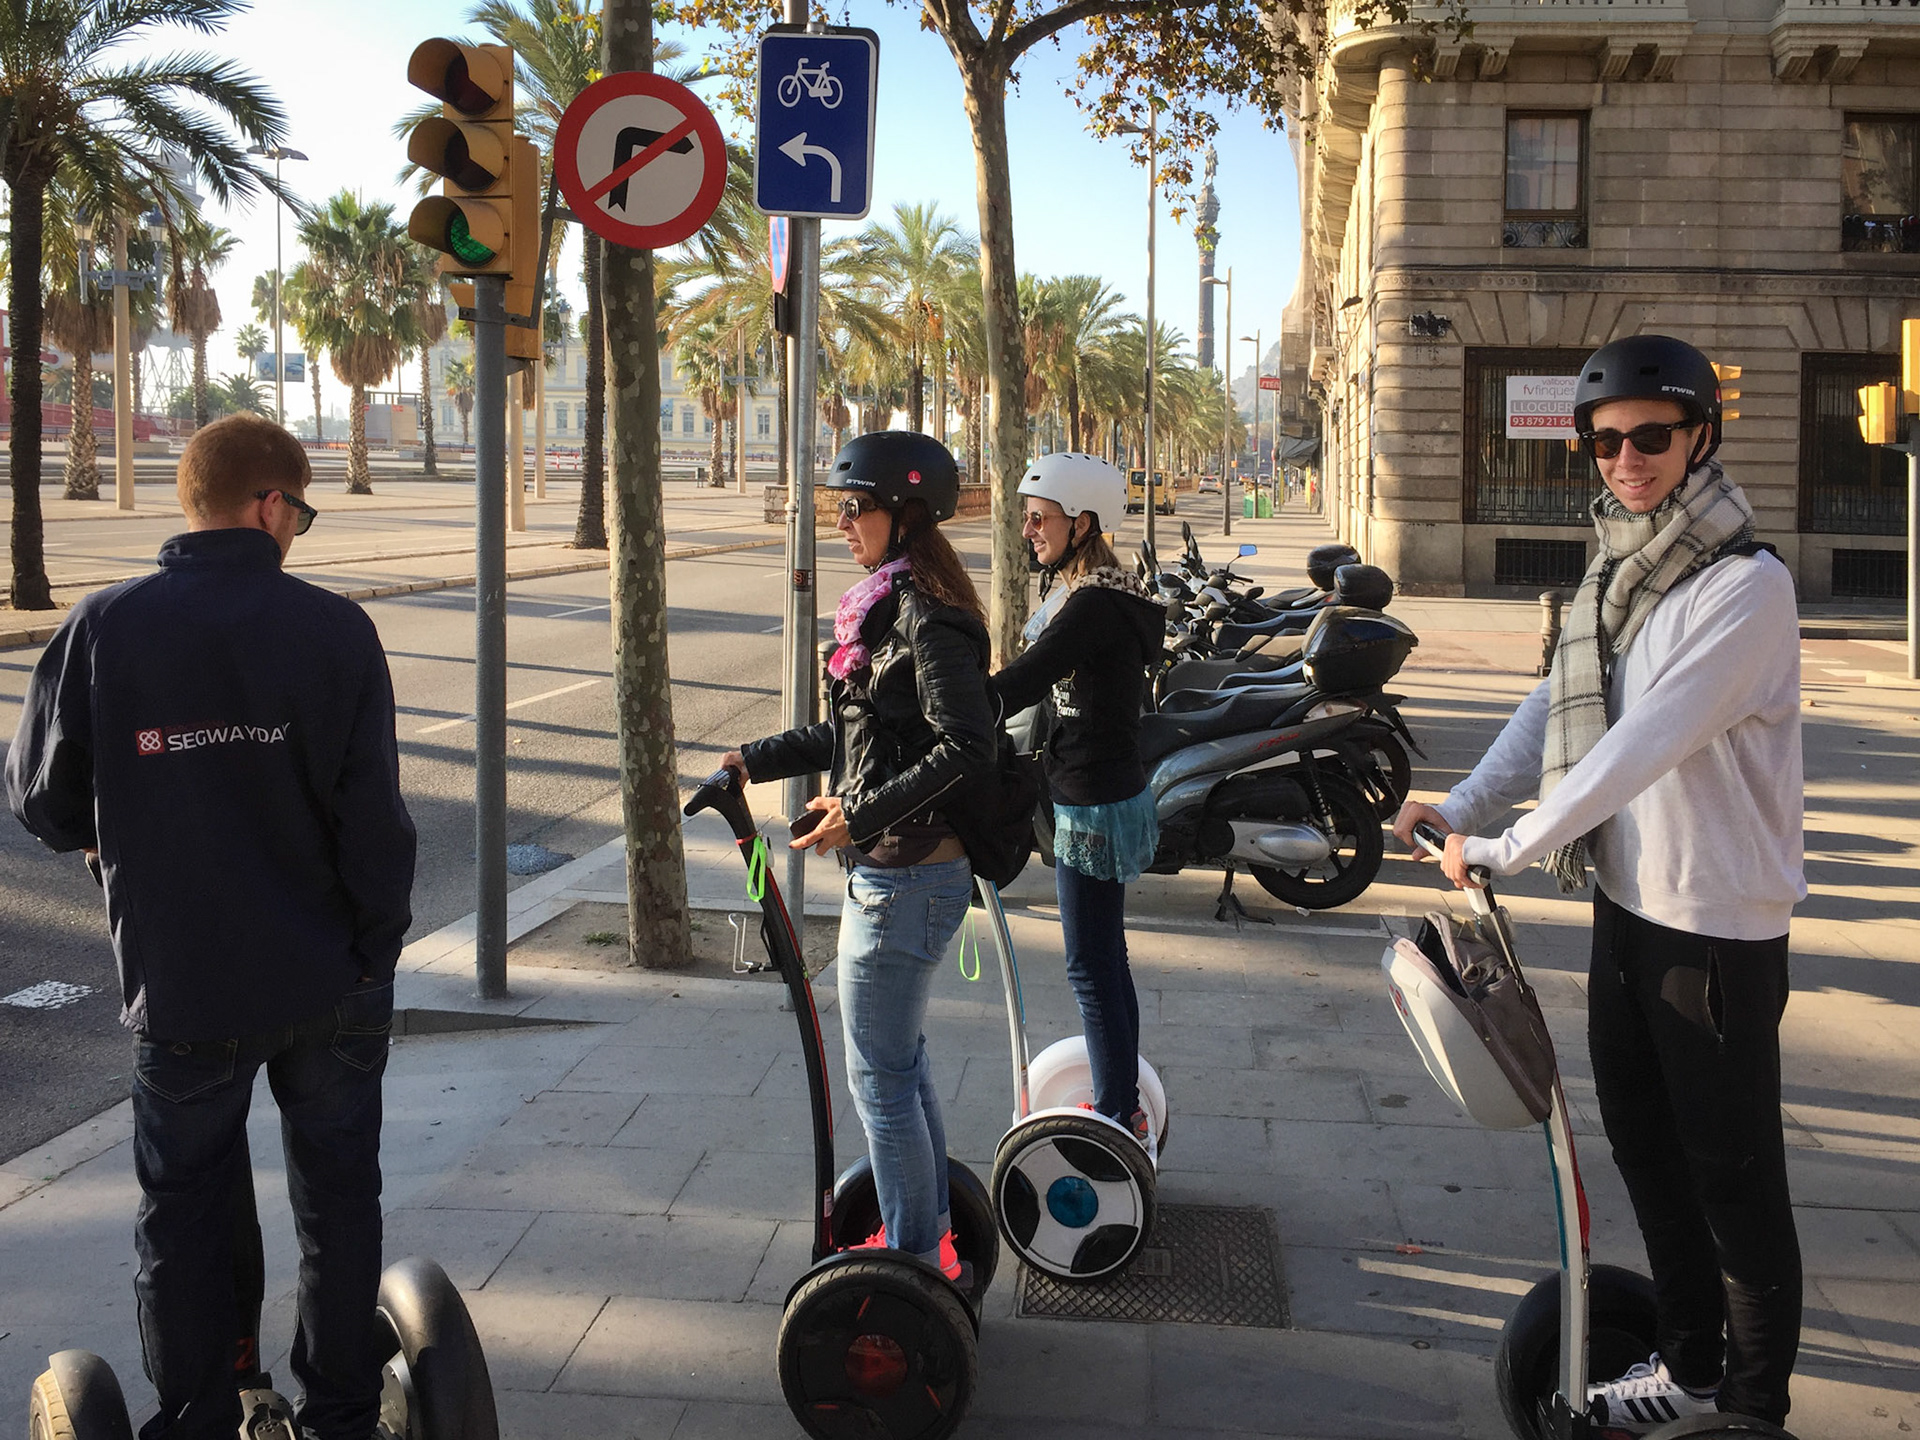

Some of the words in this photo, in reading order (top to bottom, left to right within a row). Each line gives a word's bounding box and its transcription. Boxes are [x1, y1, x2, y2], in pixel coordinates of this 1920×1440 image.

[1513, 401, 1574, 413] LLOGUER
[1512, 416, 1525, 426] 93
[1526, 416, 1545, 426] 879
[1546, 416, 1557, 426] 21
[1560, 416, 1572, 426] 64
[167, 722, 290, 752] SEGWAYDAY
